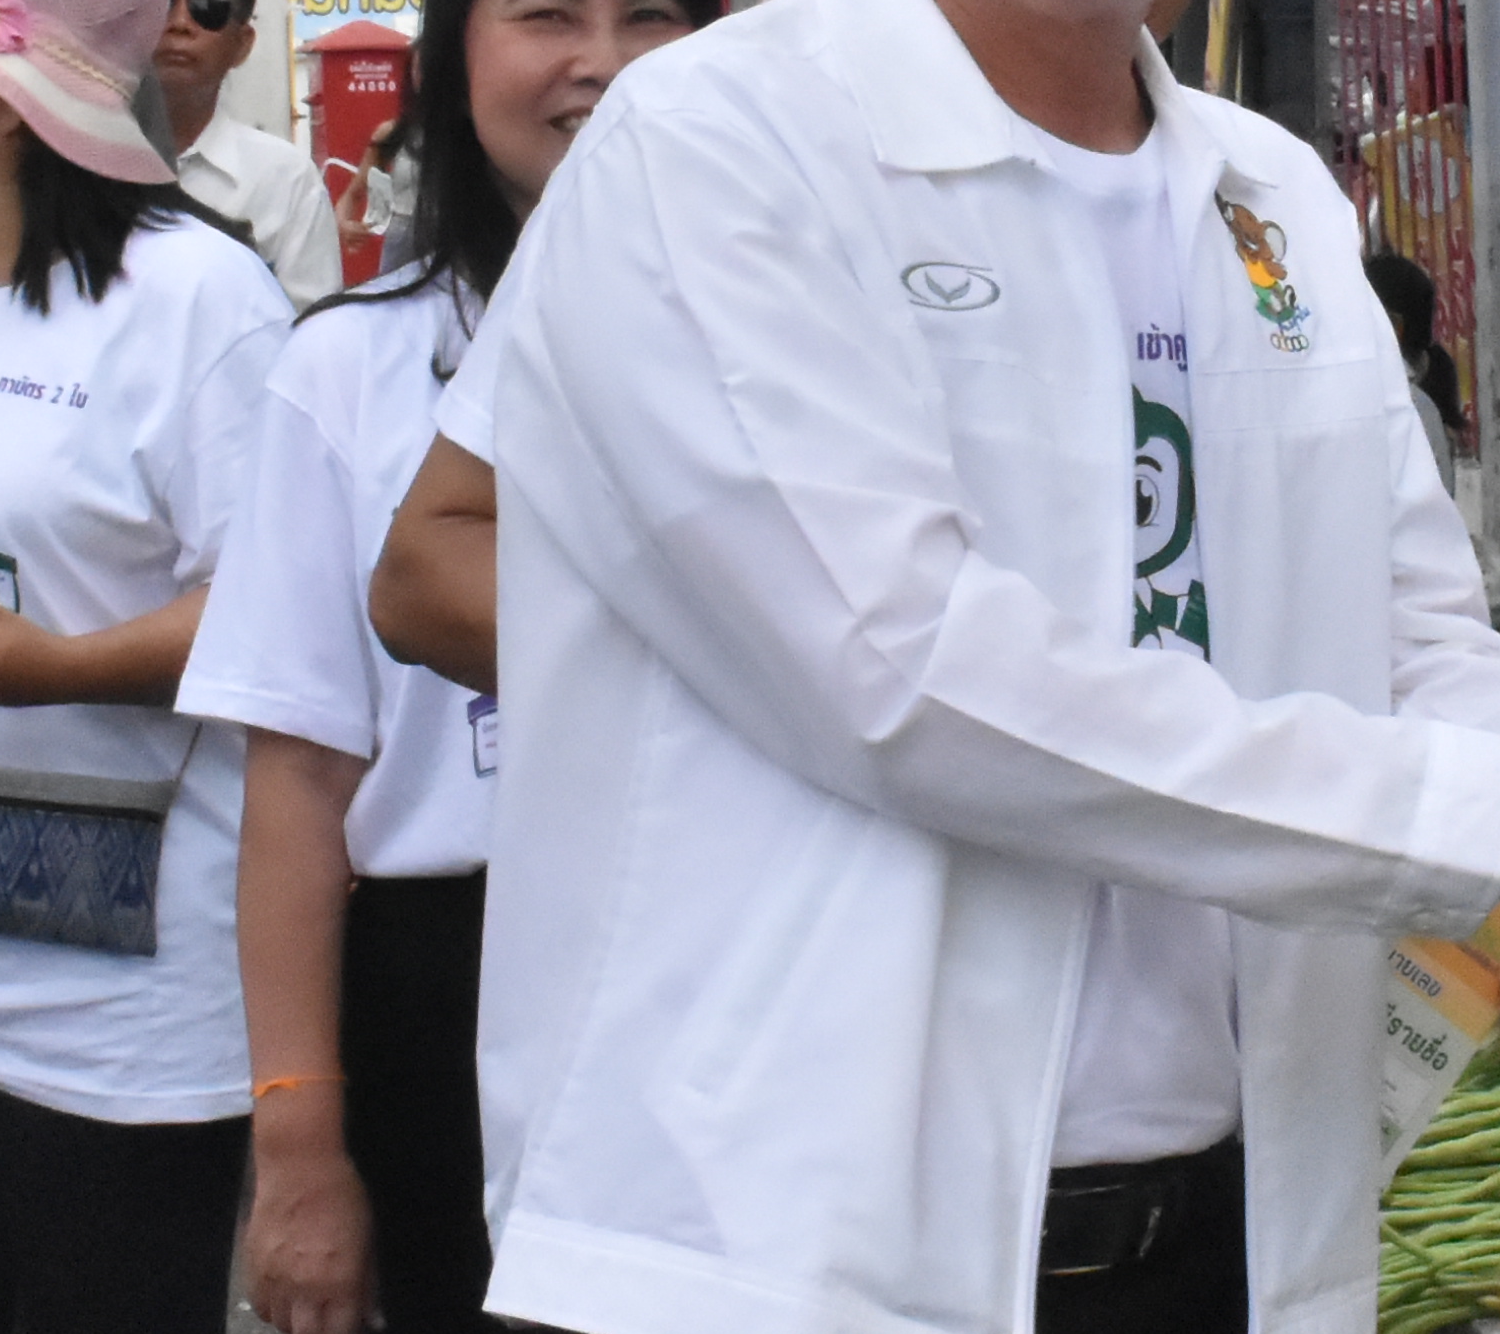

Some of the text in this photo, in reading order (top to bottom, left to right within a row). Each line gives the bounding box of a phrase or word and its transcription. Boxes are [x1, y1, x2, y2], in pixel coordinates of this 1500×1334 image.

[1137, 323, 1188, 372] เข้าคู
[50, 385, 64, 404] 2
[69, 382, 89, 409] ใบ
